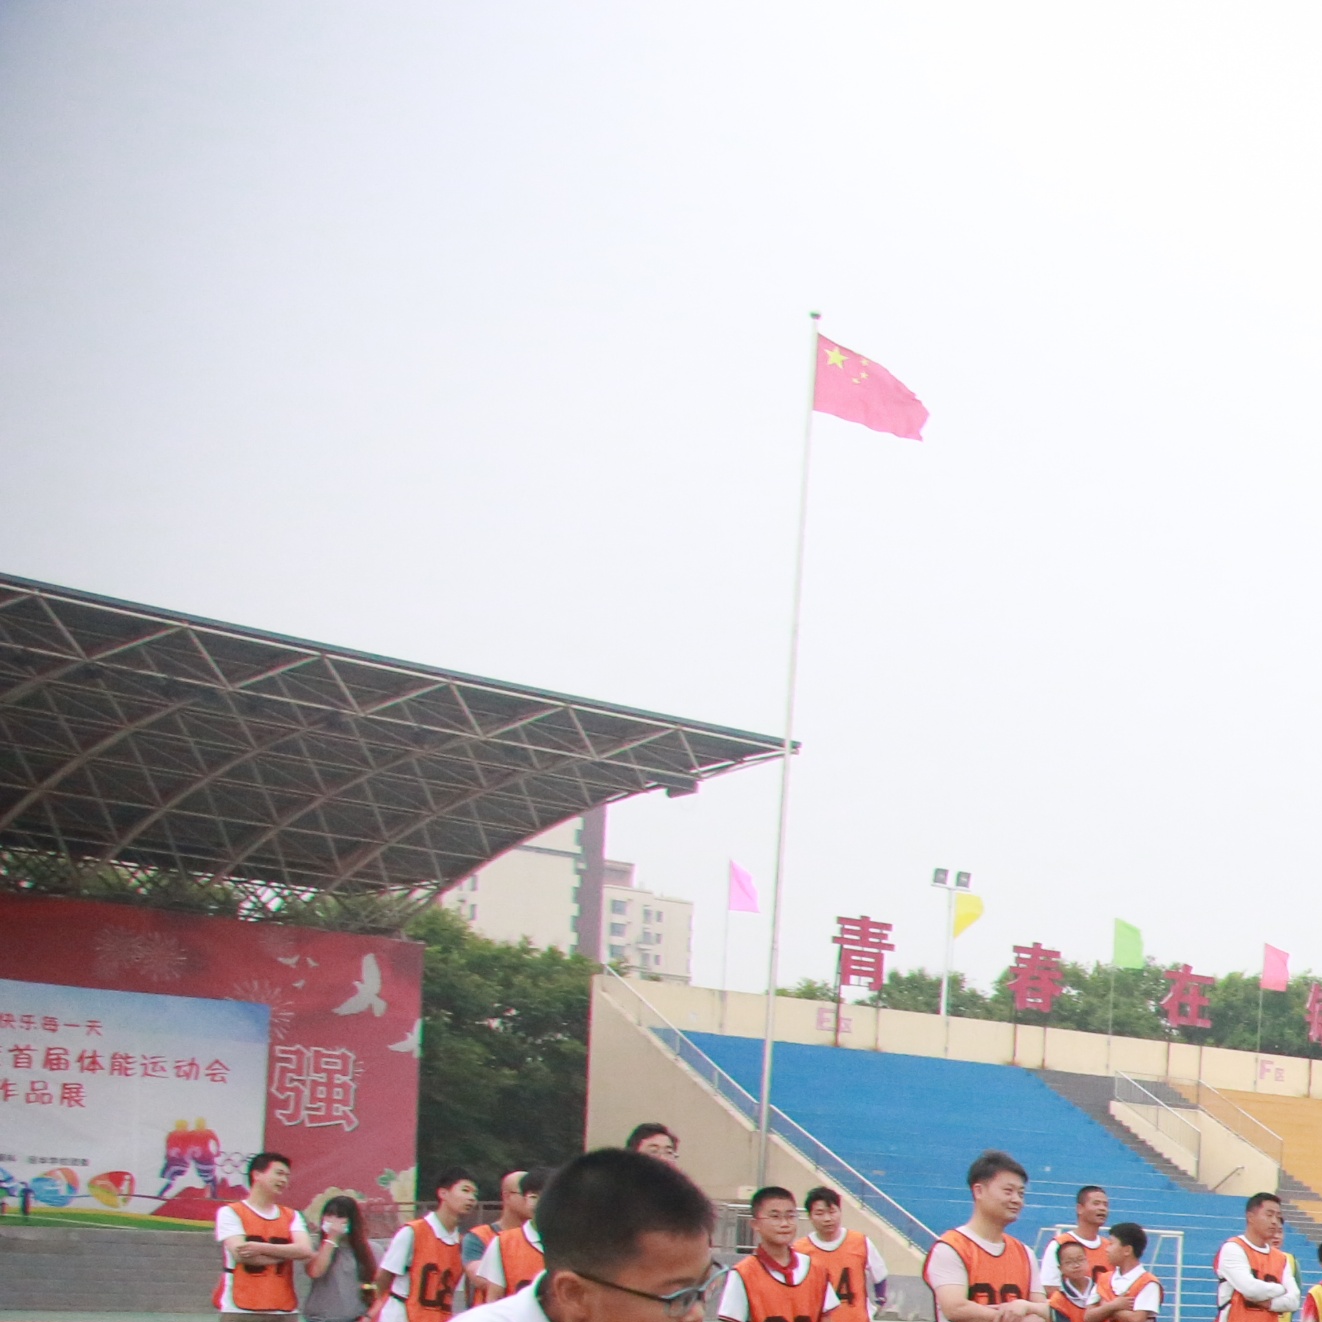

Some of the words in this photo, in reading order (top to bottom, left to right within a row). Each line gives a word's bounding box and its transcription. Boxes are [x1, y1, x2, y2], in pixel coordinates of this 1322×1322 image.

[0, 1044, 231, 1084] 首届体能运动会
[272, 1043, 359, 1132] 强
